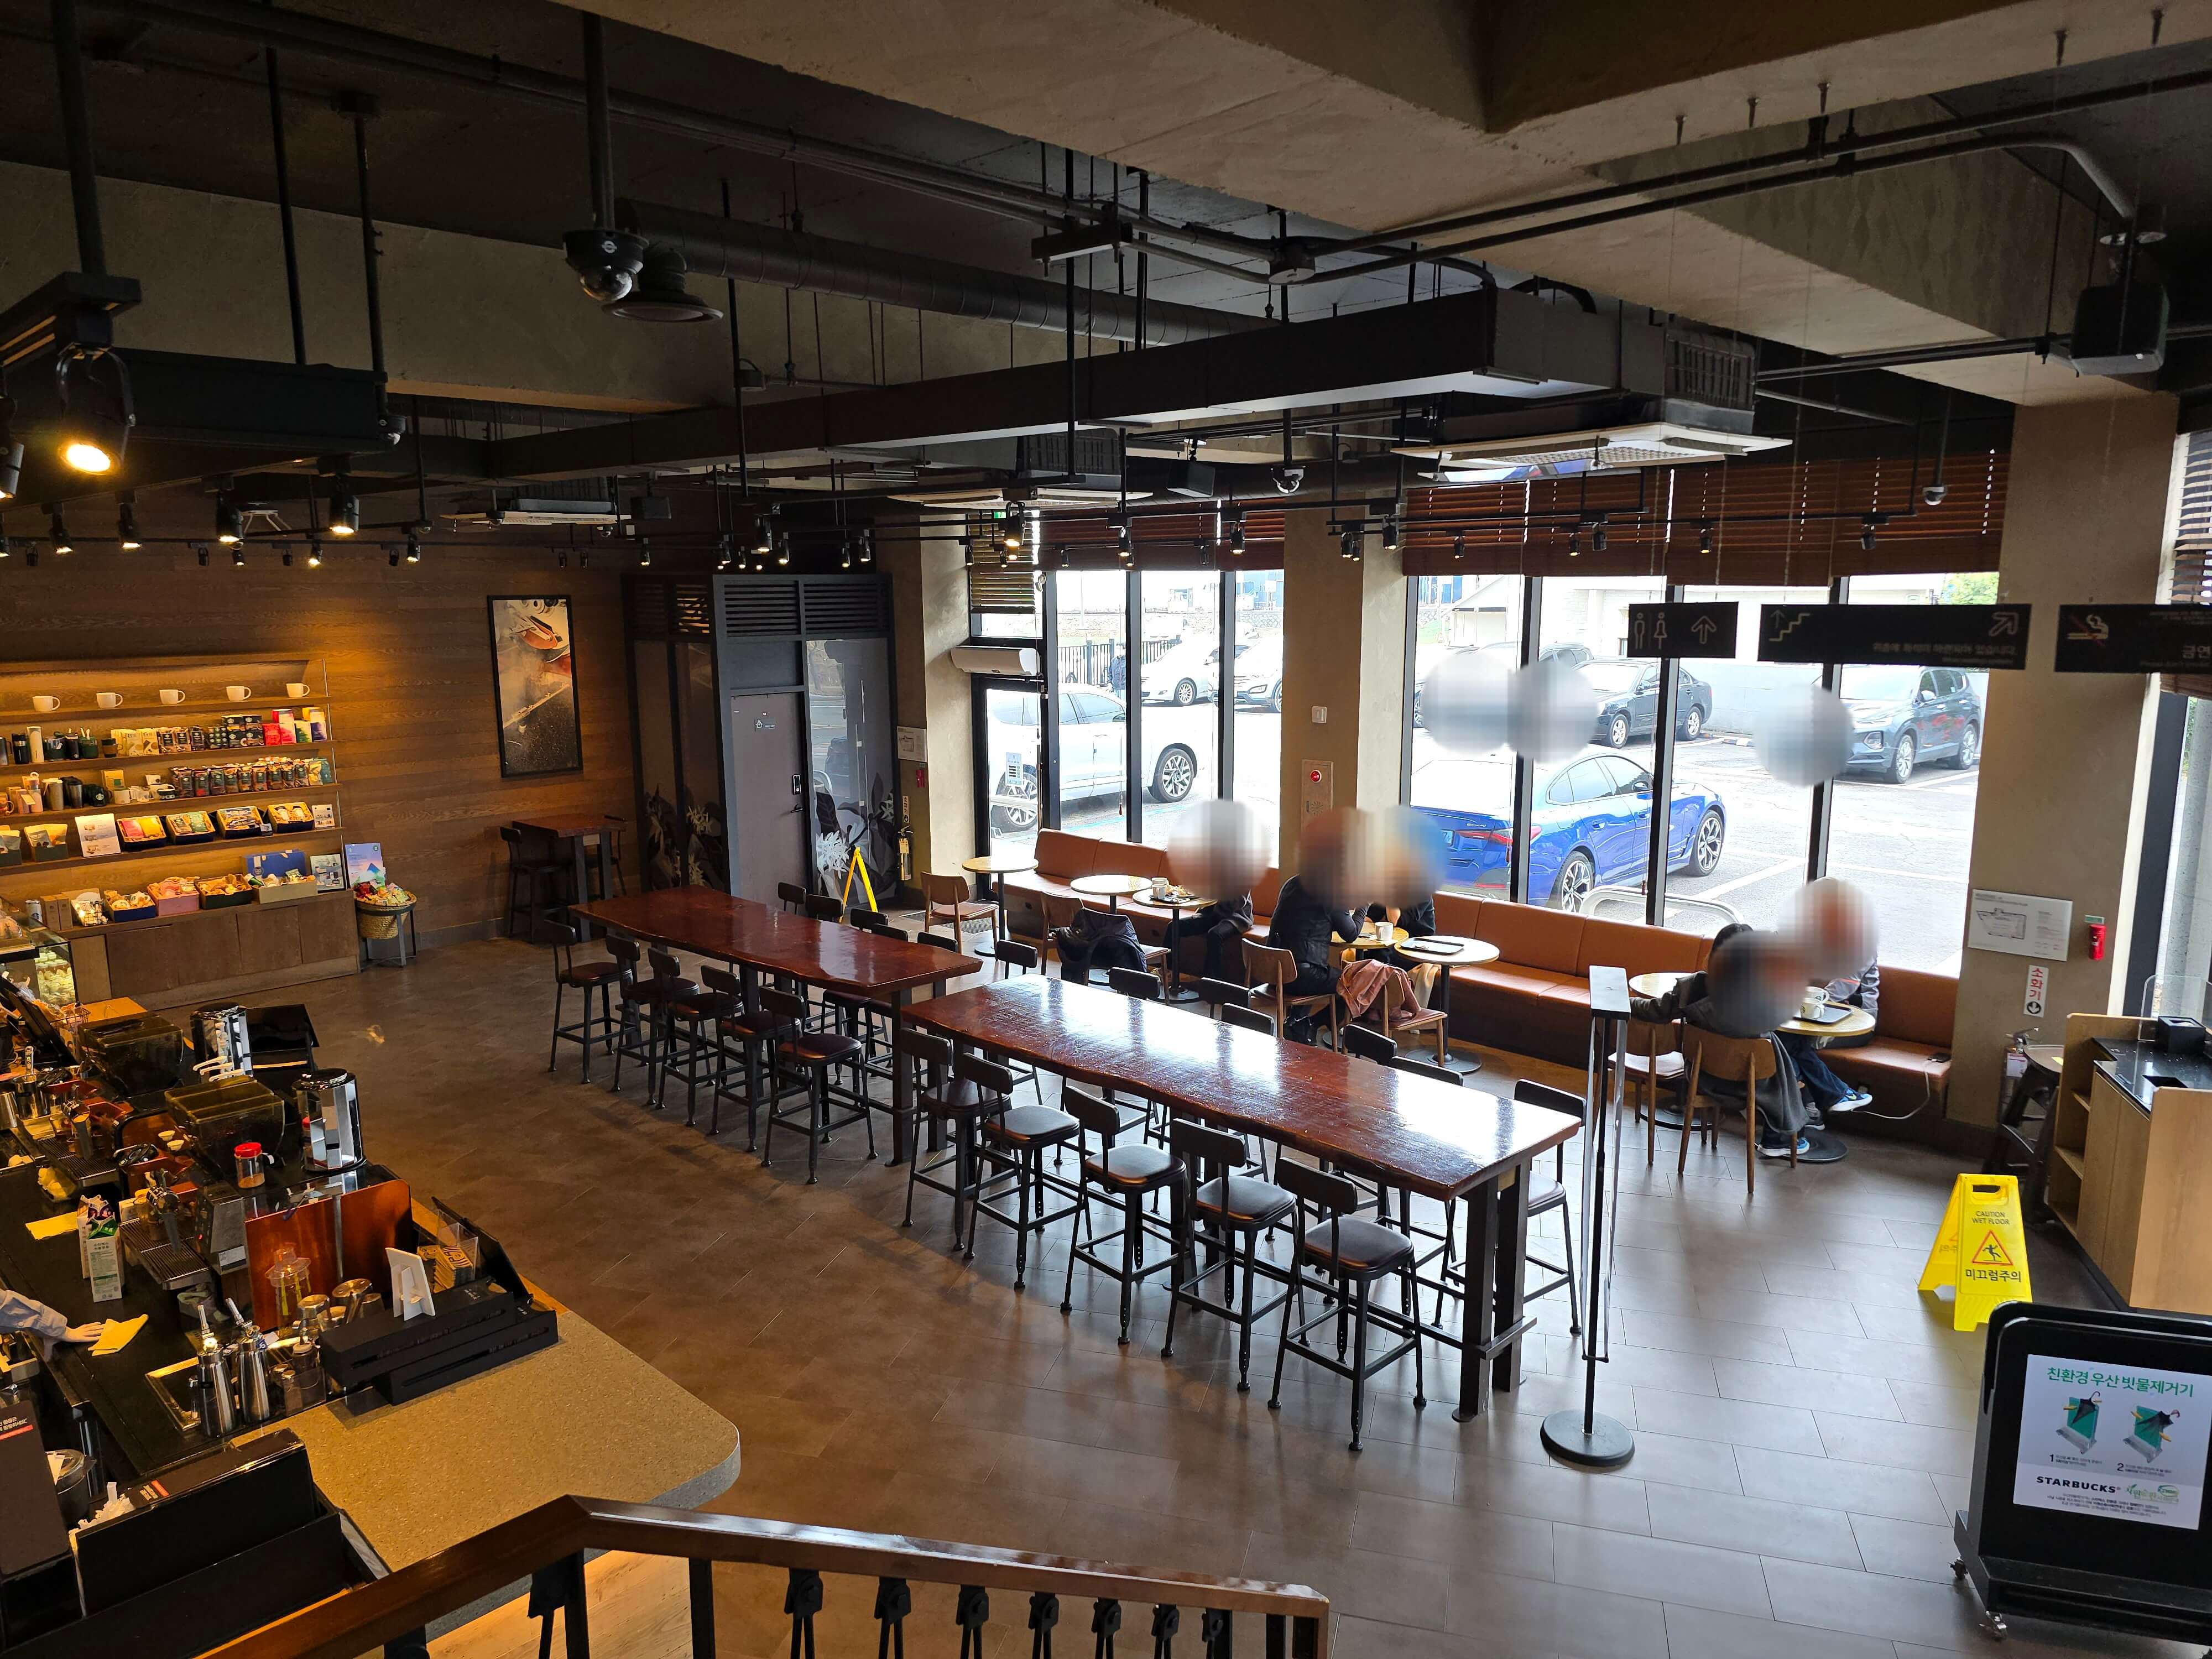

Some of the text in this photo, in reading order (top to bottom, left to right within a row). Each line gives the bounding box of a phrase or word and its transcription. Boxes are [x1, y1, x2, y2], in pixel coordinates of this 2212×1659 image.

[2182, 645, 2210, 659] 금연
[2029, 968, 2043, 1001] 소화기
[1965, 1269, 2021, 1282] 미끄럼주의
[2047, 1367, 2194, 1397] 친환경 우산 빗물제거기
[2049, 1454, 2054, 1463] 1
[2117, 1463, 2124, 1472] 2
